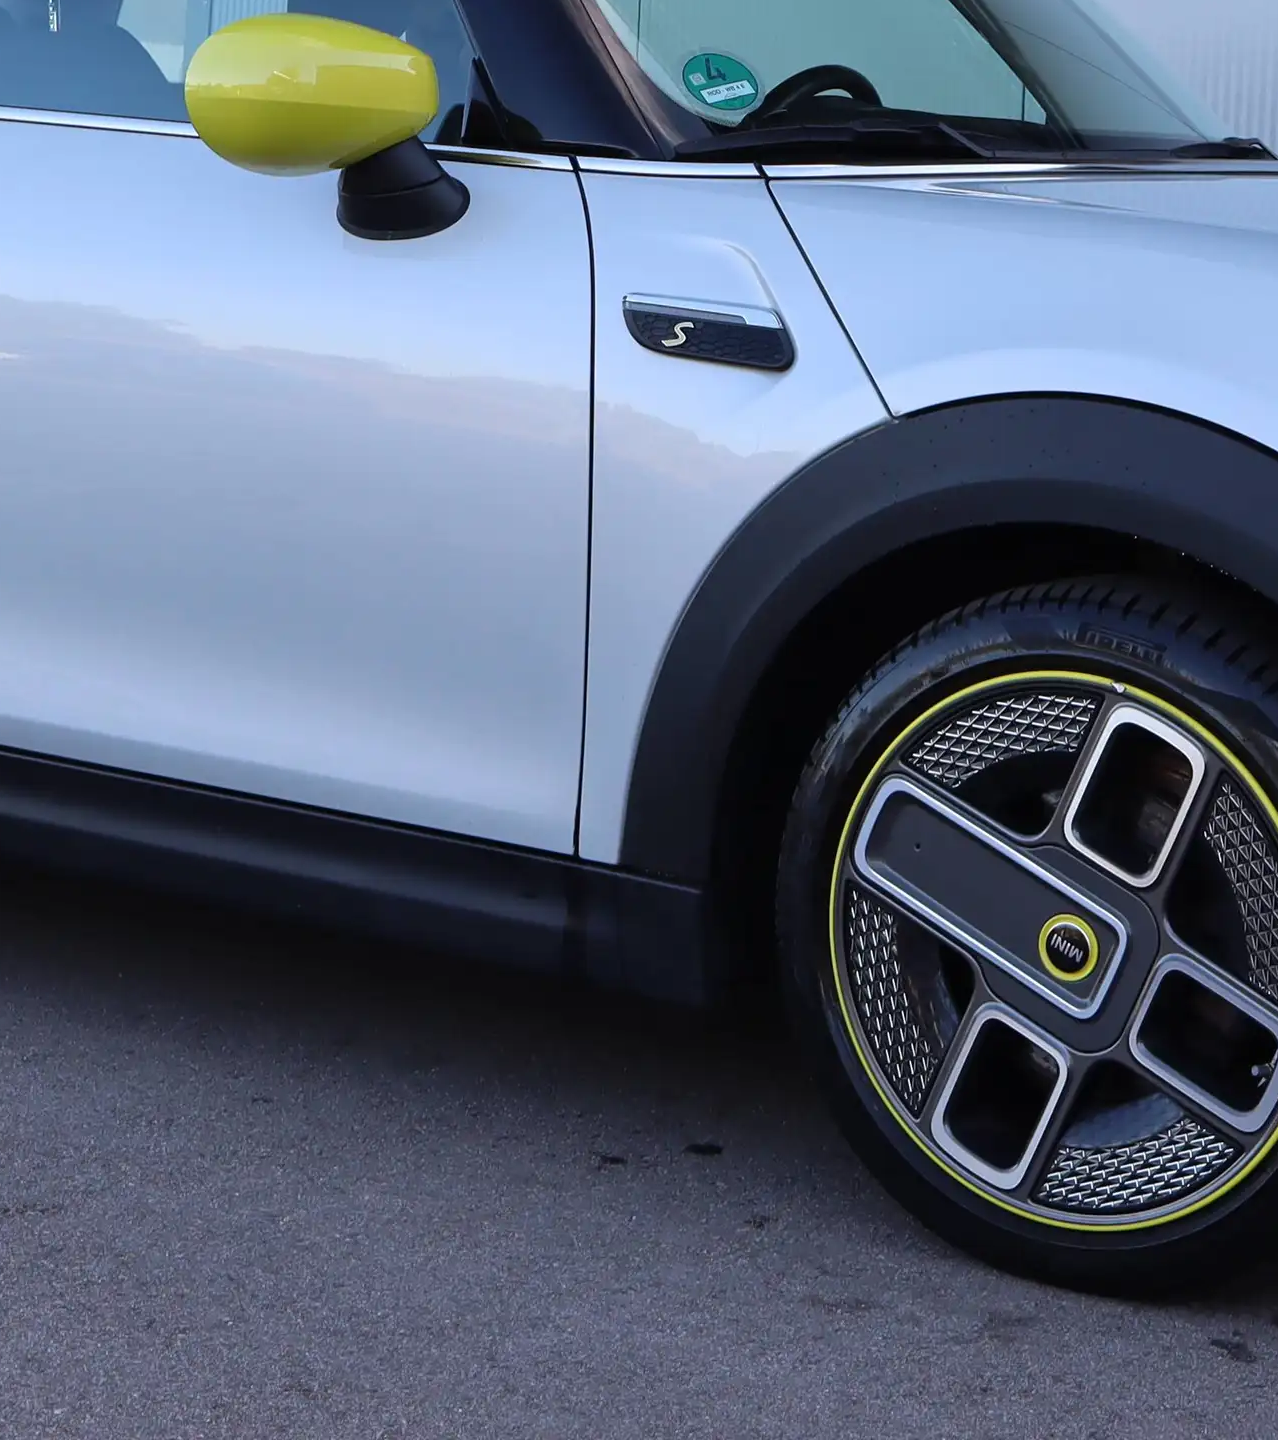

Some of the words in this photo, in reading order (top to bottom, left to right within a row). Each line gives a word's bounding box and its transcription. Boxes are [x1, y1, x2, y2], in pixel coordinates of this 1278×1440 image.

[705, 58, 726, 80] 4
[661, 321, 695, 348] S
[1049, 932, 1084, 964] MINI
